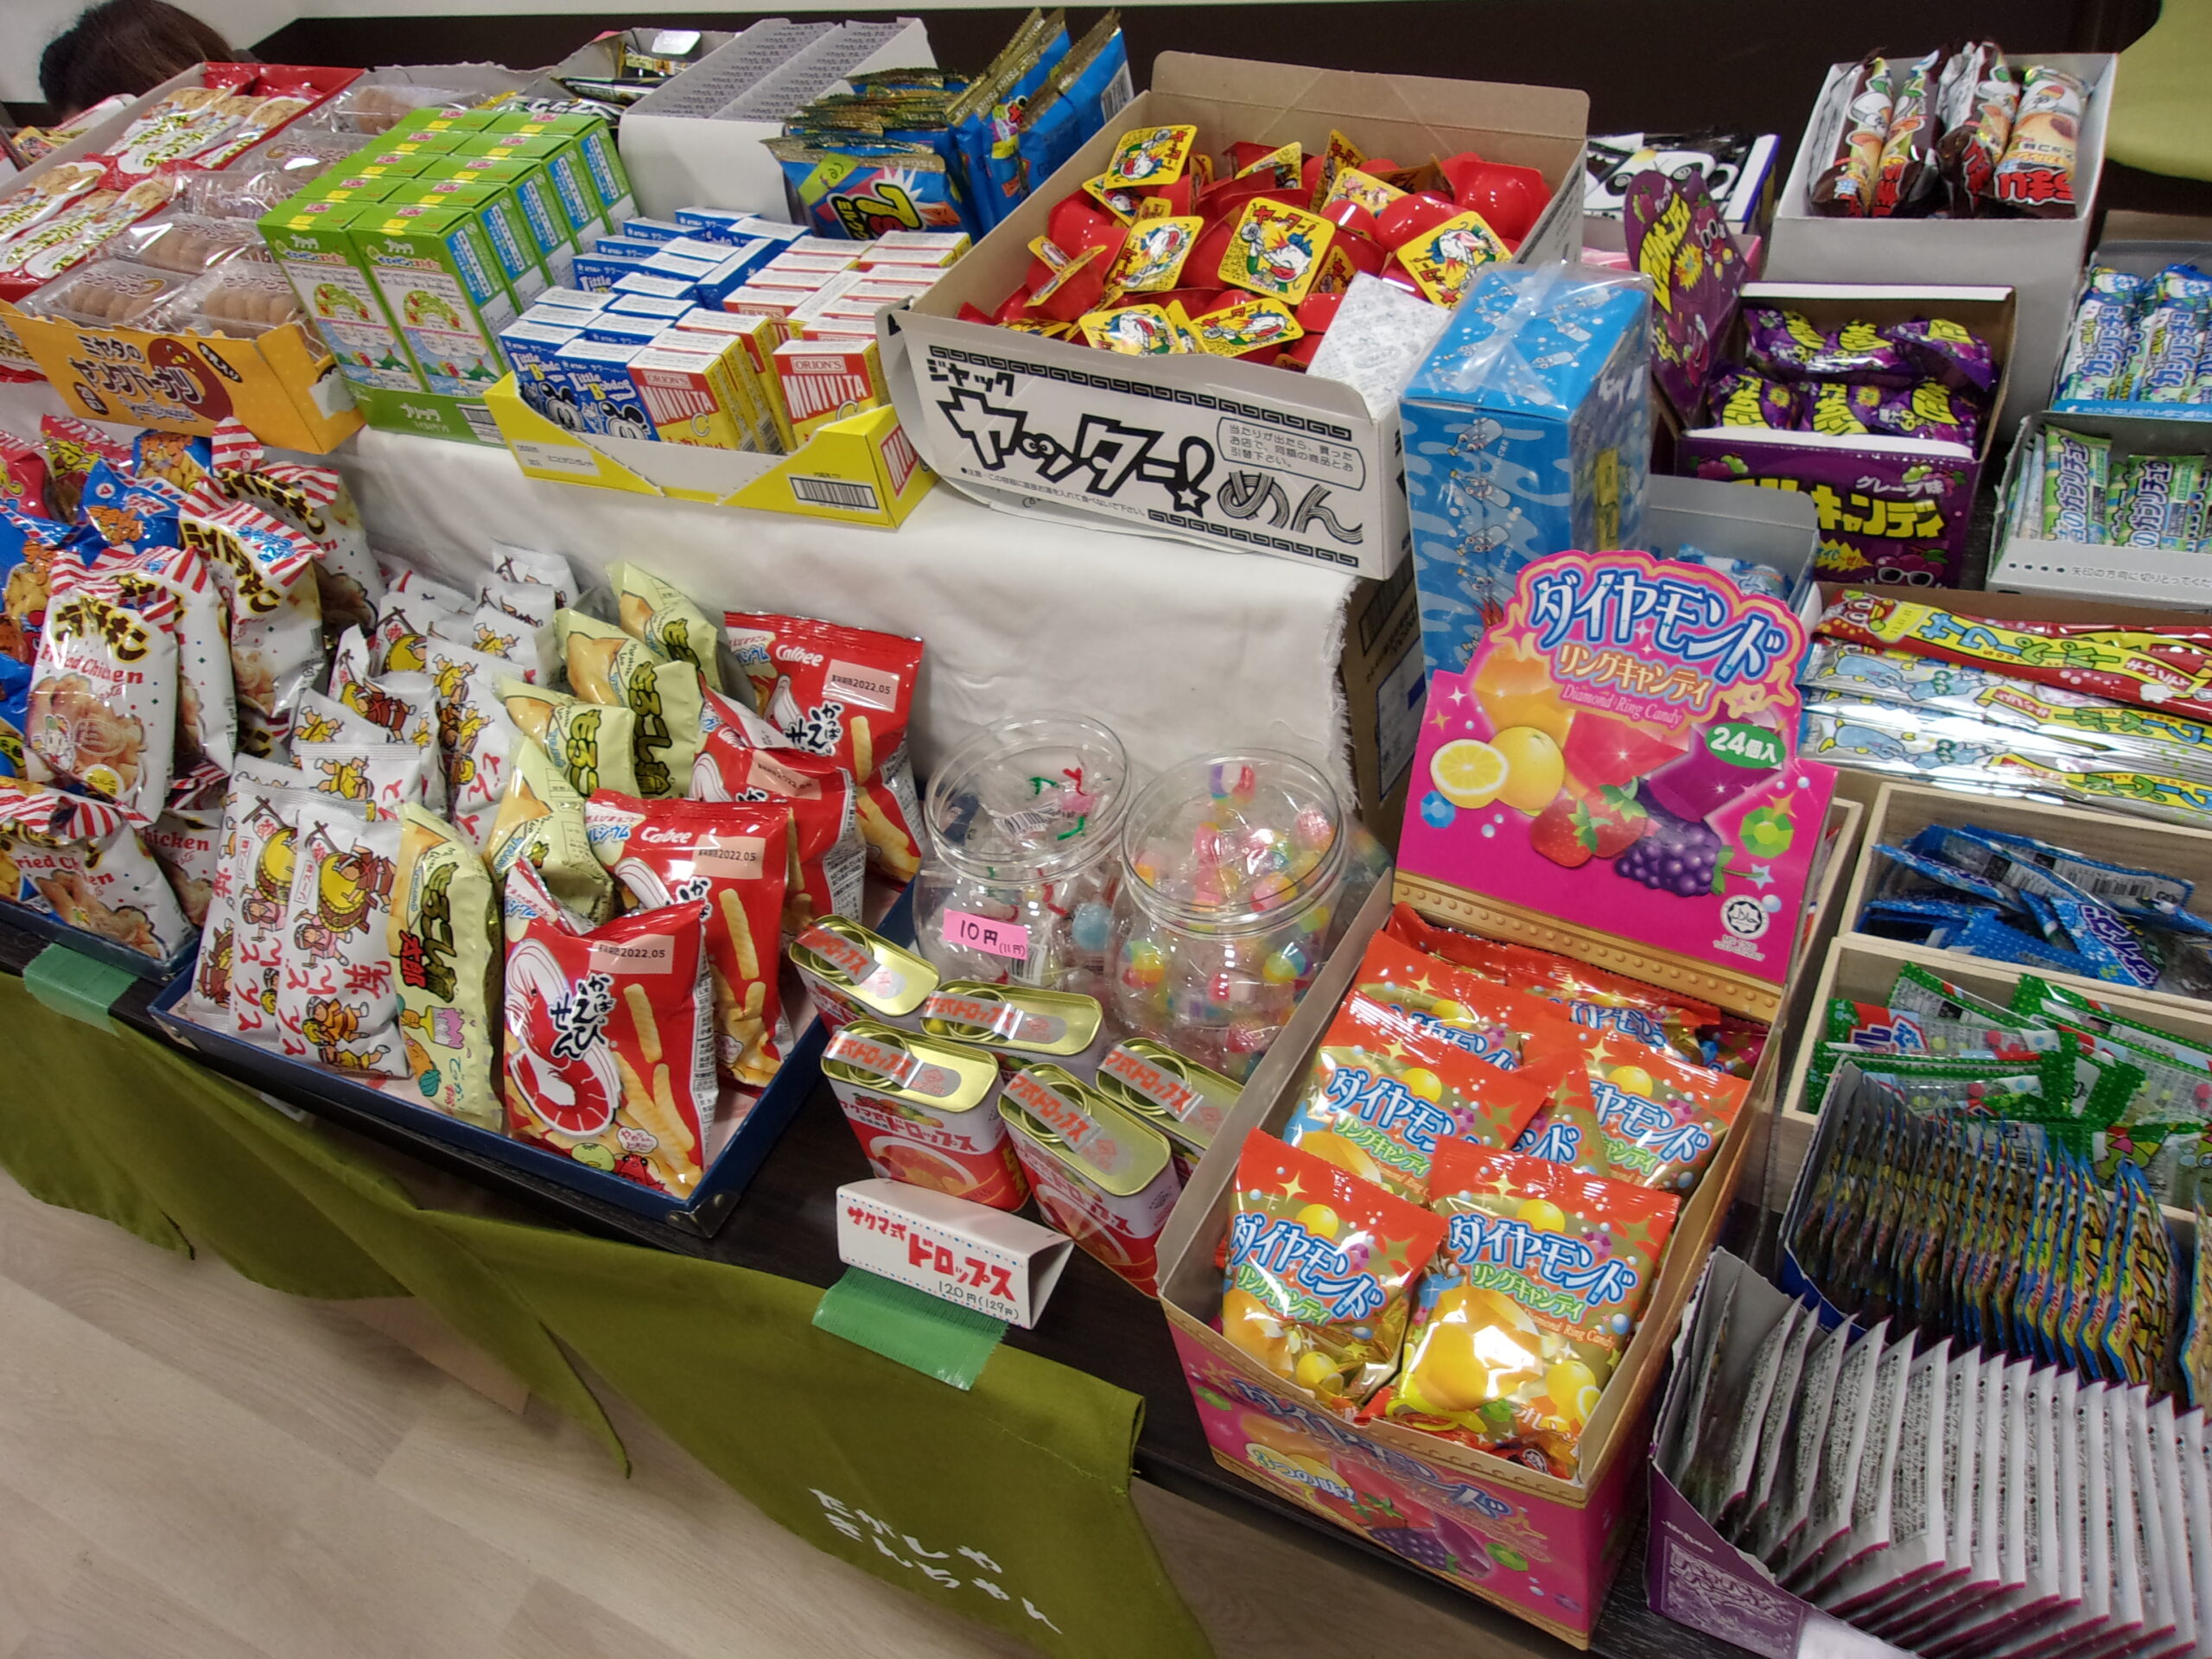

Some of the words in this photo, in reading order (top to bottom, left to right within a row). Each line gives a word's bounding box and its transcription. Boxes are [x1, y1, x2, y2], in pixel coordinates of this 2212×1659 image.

[78, 334, 147, 363] ミヤタの
[793, 357, 843, 372] ORION'S
[68, 355, 204, 404] ヤングドーナツ
[567, 372, 603, 392] Little
[645, 373, 690, 389] ORION'S
[781, 374, 868, 420] MINIVITA
[926, 359, 1016, 398] ジャック
[638, 385, 715, 424] MINIVITA
[690, 412, 711, 438] C
[936, 385, 1216, 518] ヤッター!
[1216, 469, 1363, 545] めん
[1854, 474, 1946, 498] グレープ味
[2129, 460, 2173, 549] のガブリチュウ
[1763, 478, 1946, 540] キャンディ
[1531, 568, 1786, 683] ダイヤモンド
[1918, 611, 2122, 670] サワーペーパー
[776, 644, 825, 668] Calbee
[1558, 643, 1714, 708] リングキャンディ
[1560, 683, 1613, 711] Diamond
[1615, 693, 1645, 722] Ring
[1643, 700, 1687, 728] Candy
[2055, 706, 2212, 750] ワーペーパー
[1707, 724, 1778, 767] 24個入
[588, 823, 632, 846] ルシウム
[640, 826, 694, 845] Calbee
[15, 855, 58, 870] ried
[958, 918, 1000, 947] 10円
[998, 940, 1027, 958] (11円)
[1327, 1067, 1460, 1154] ダイヤモ
[1590, 1080, 1713, 1161] ヤモンド
[847, 1205, 907, 1243] サクマ式
[908, 1232, 1016, 1303] ドロップス
[1230, 1213, 1384, 1320] ダイヤモンド
[1448, 1213, 1637, 1306] ダイヤモンド
[1471, 1263, 1586, 1322] リングキャンディ
[807, 1486, 1003, 1574] だがしや
